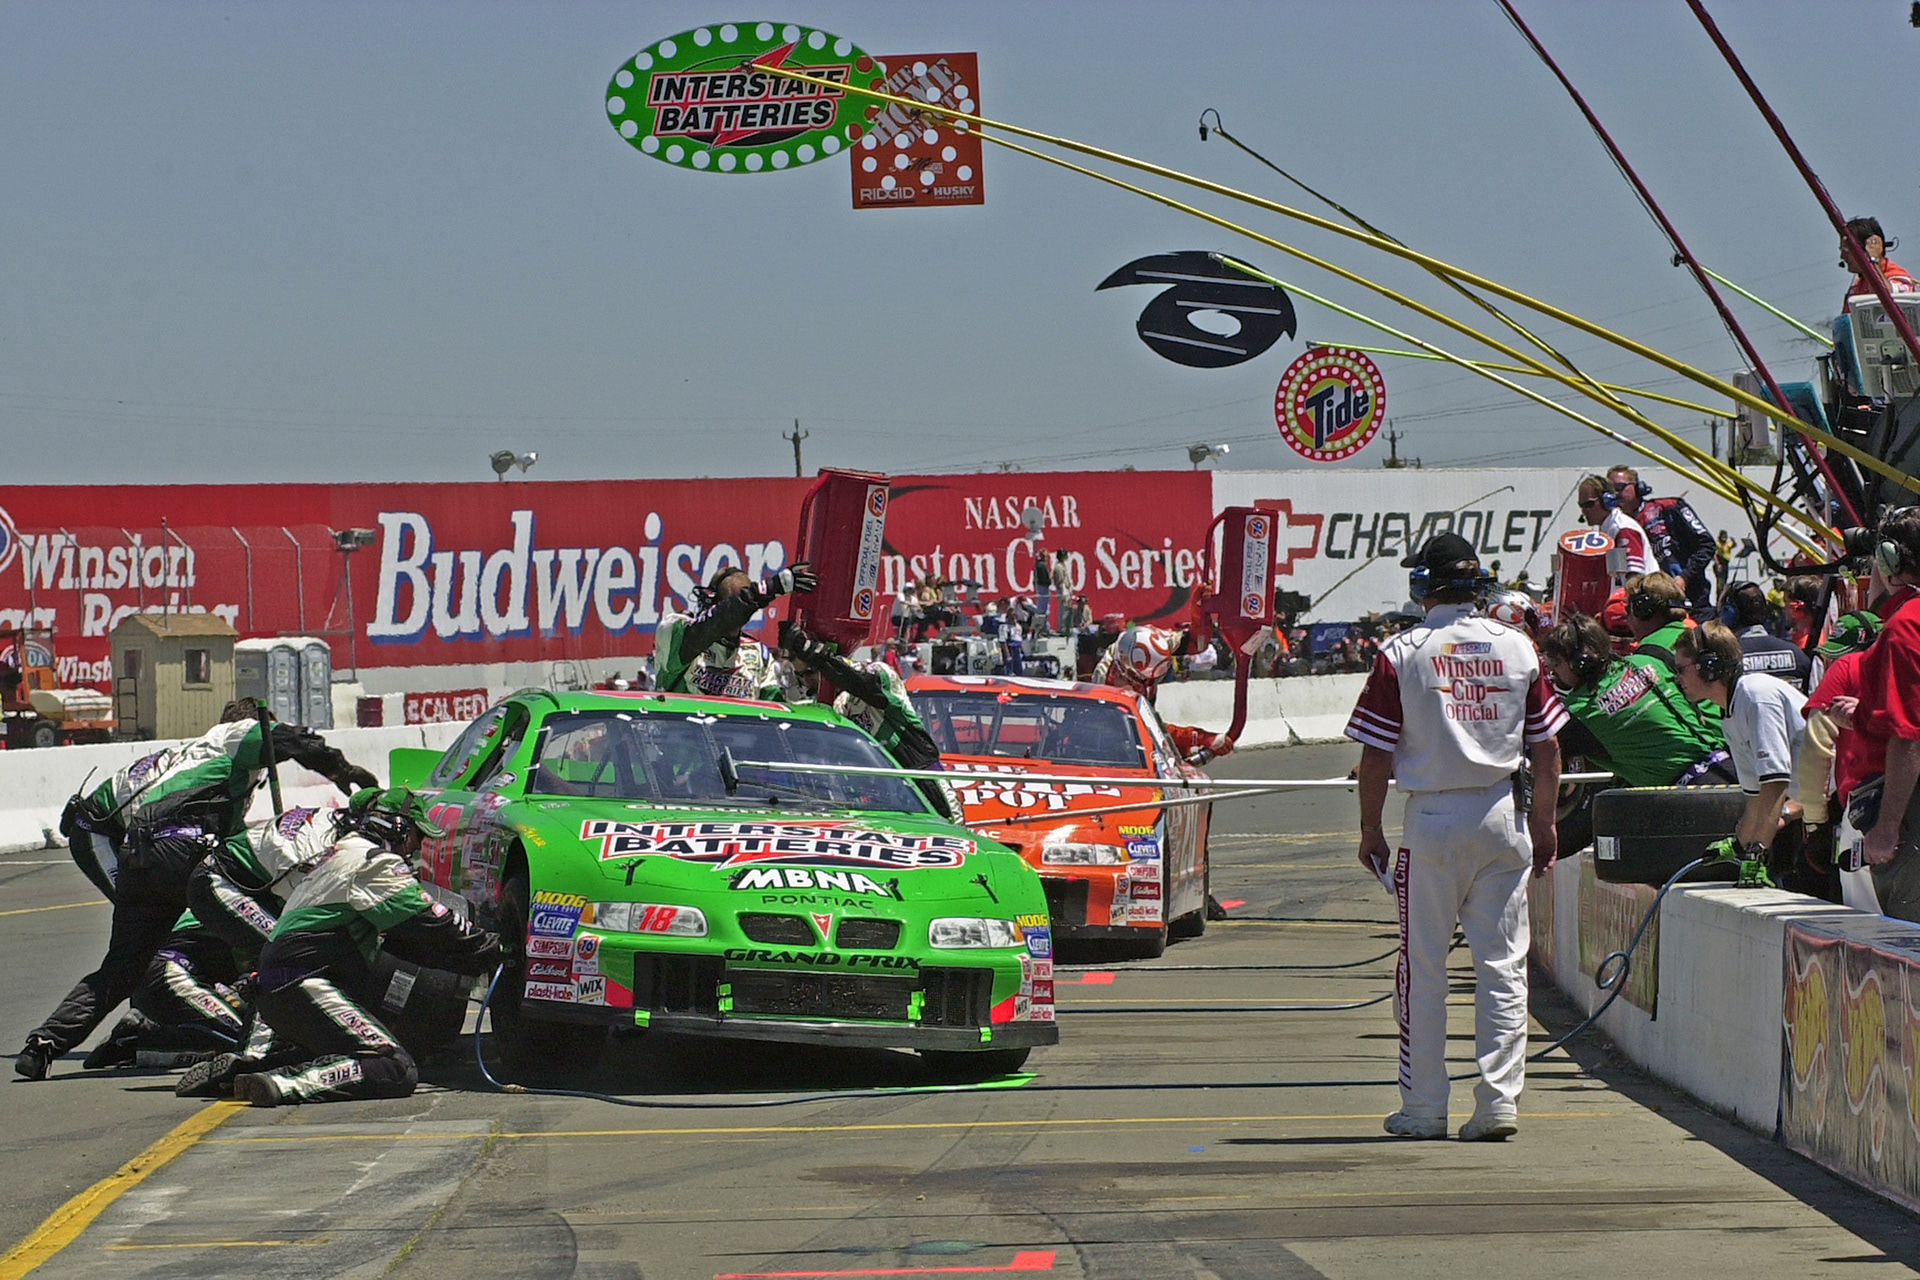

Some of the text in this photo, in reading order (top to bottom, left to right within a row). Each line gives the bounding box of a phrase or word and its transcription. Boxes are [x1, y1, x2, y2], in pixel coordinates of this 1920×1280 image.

[653, 70, 844, 101] INTERSTATE
[659, 100, 831, 132] BATTERIES
[860, 187, 915, 200] RIDGID
[933, 186, 976, 197] HUSKY
[1305, 385, 1370, 450] Tide
[873, 493, 884, 511] 76
[1252, 520, 1264, 536] 76
[1324, 509, 1554, 560] CHEVROLET
[1566, 532, 1606, 550] 76
[19, 534, 196, 590] Winston
[1005, 536, 1086, 596] Cp
[860, 593, 870, 612] 76
[1248, 597, 1260, 612] 76
[1455, 643, 1490, 654] NASCAR
[1430, 655, 1504, 678] Winston
[1743, 653, 1793, 671] SIMPSON
[1451, 679, 1487, 703] Cup
[420, 697, 452, 722] CAL
[453, 694, 487, 720] FED
[1446, 702, 1498, 721] Official
[591, 822, 969, 851] INTERSTATE
[1118, 826, 1156, 836] MOOG
[613, 837, 960, 867] BATTERIES
[1394, 851, 1408, 884] Cup
[734, 868, 890, 897] MBNA
[532, 889, 588, 908] MOOG
[762, 896, 873, 909] PONTIAC
[533, 911, 575, 932] CLEVITE
[639, 906, 677, 932] 18
[1016, 915, 1049, 927] MOOG
[532, 940, 571, 956] SIMPSON
[724, 949, 924, 970] GRAND PRIX
[580, 979, 603, 995] WIX
